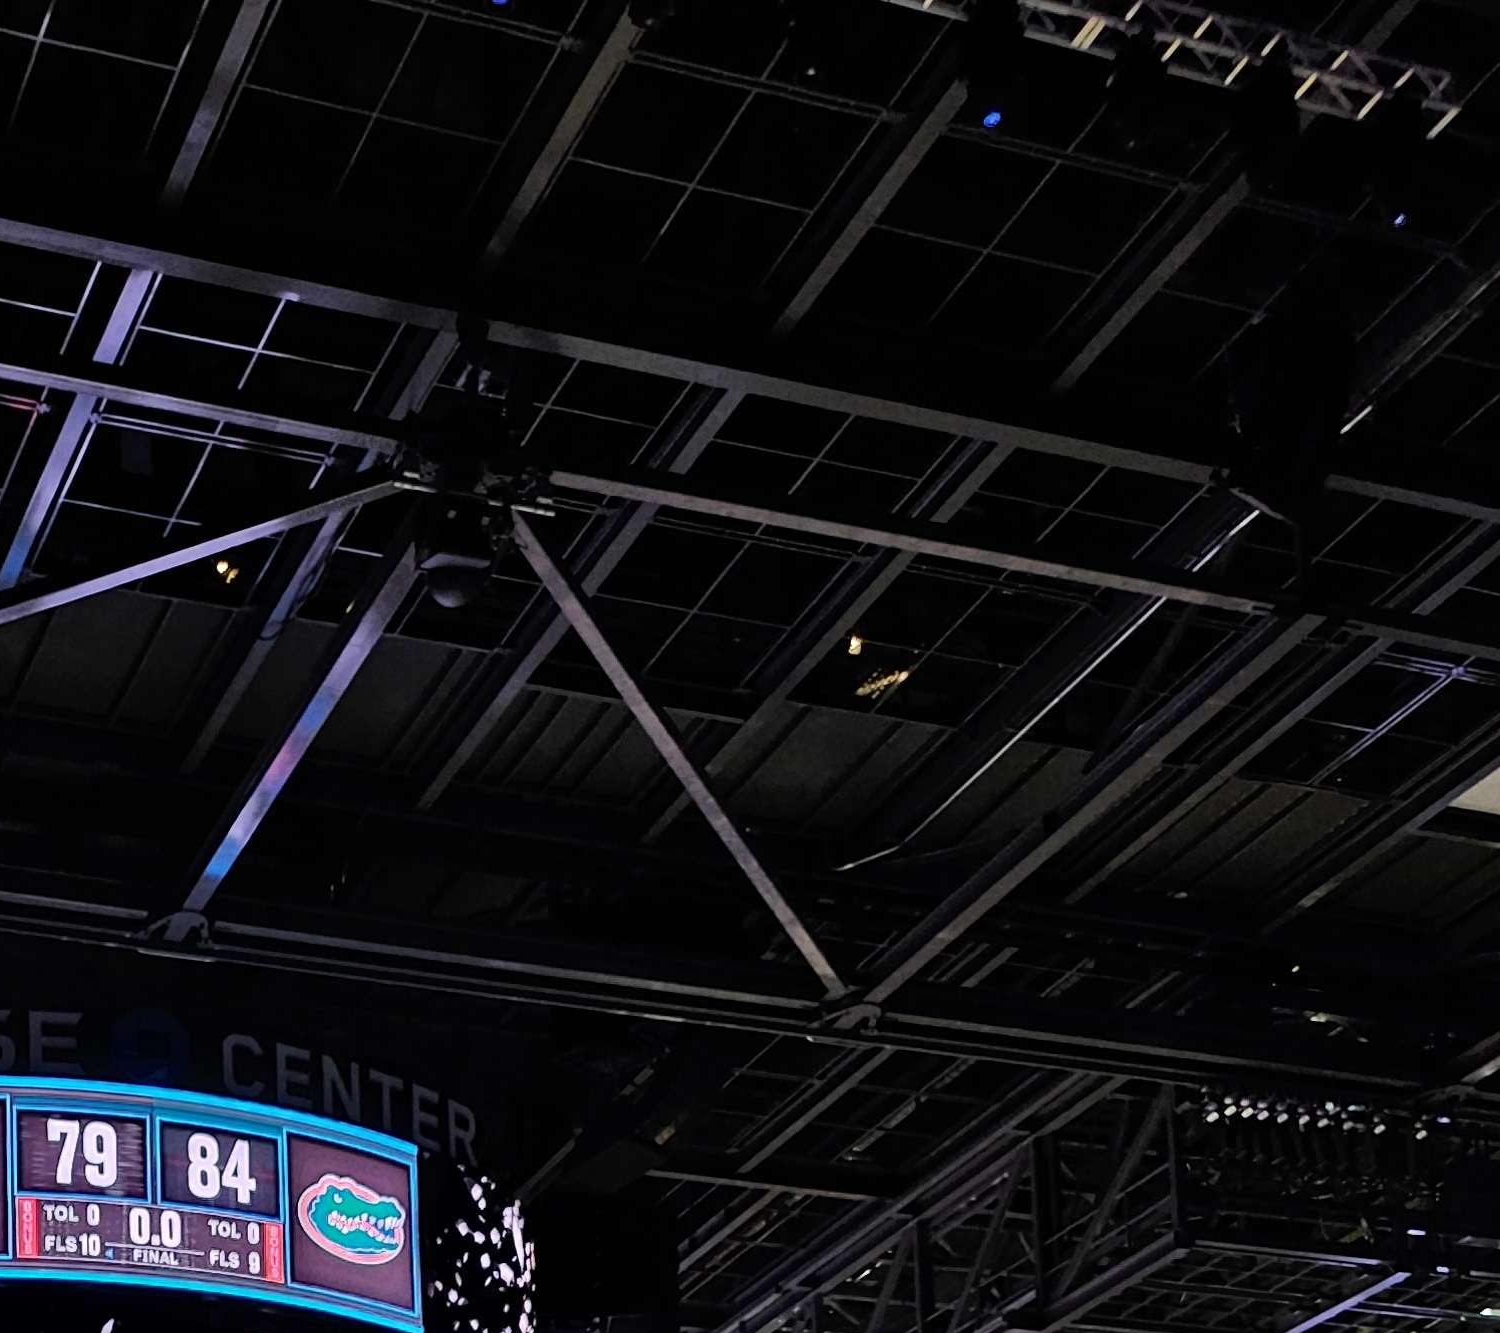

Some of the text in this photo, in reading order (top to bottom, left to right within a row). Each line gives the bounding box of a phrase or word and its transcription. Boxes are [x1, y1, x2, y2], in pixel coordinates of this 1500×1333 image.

[222, 1033, 478, 1163] CENTER
[47, 1118, 117, 1188] 79
[188, 1133, 256, 1204] 84
[43, 1203, 100, 1226] TOL 0
[129, 1207, 182, 1247] 0.0
[44, 1233, 100, 1256] FLS 10
[207, 1218, 260, 1245] TOL 0
[133, 1248, 179, 1266] FINAL
[209, 1249, 261, 1274] FLS 9
